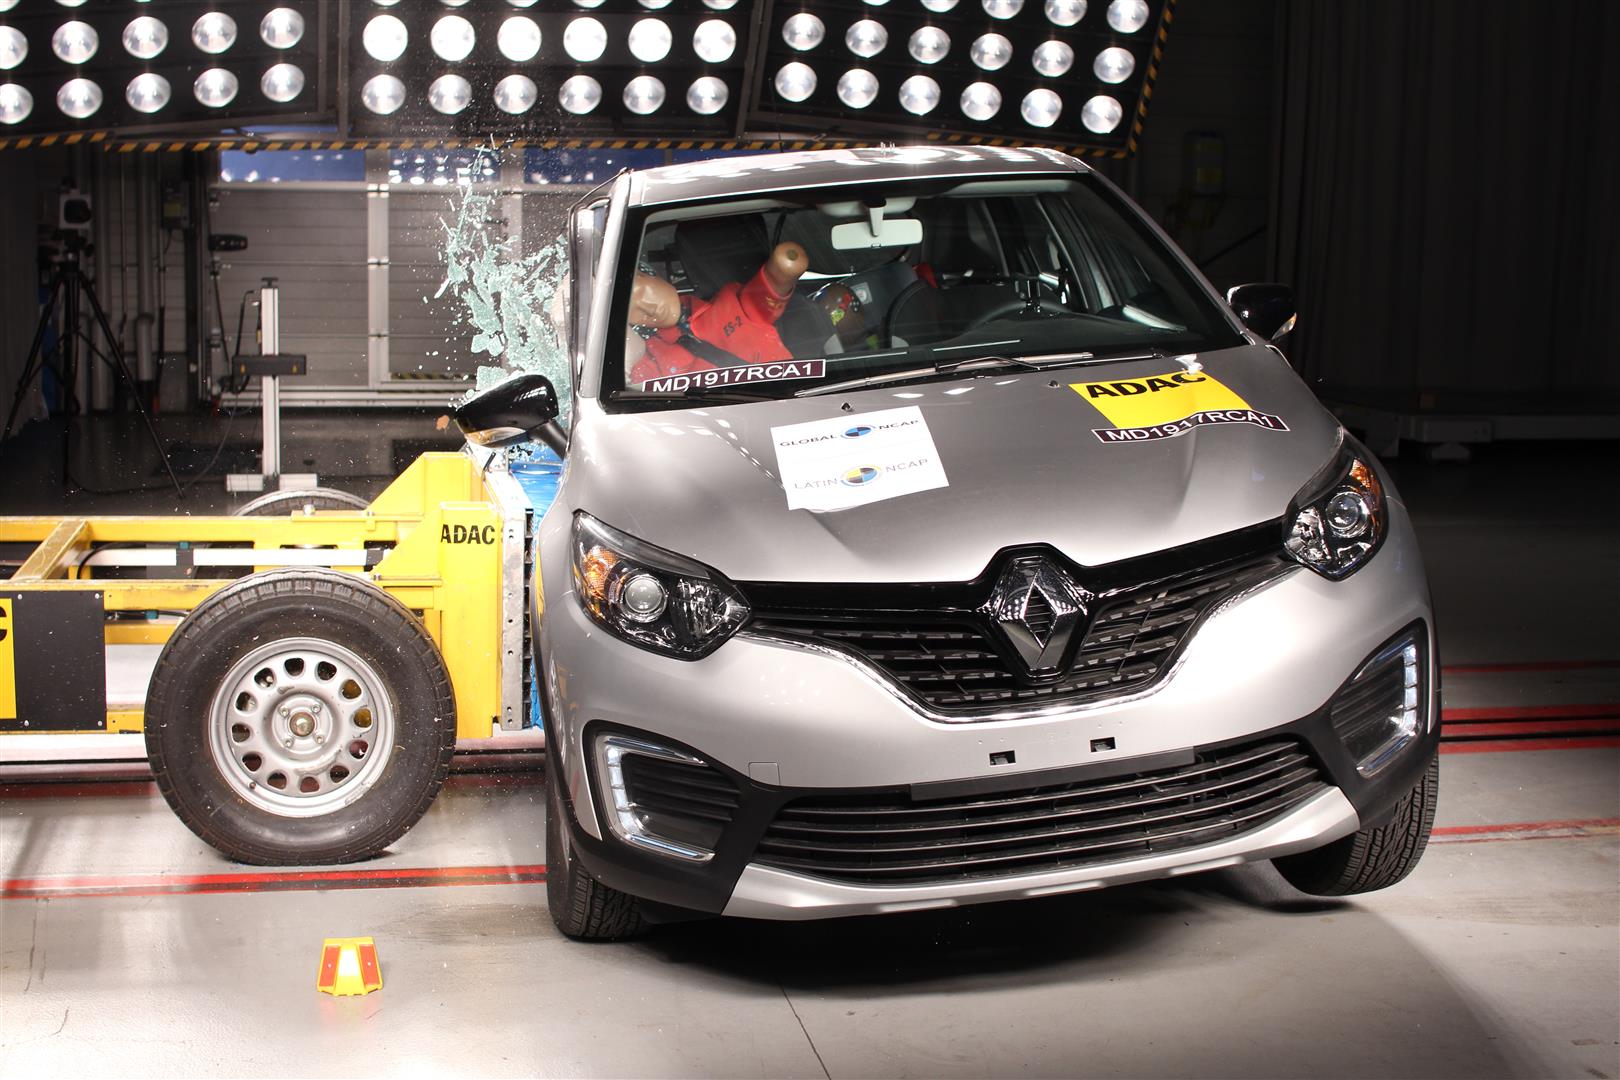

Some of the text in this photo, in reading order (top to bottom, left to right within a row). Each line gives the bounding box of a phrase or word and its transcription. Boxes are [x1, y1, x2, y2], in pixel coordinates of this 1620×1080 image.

[652, 362, 812, 393] MD1917RCA1
[1085, 372, 1206, 399] ADAC
[779, 419, 919, 447] GLOBAL NCAP
[1105, 410, 1275, 441] MD1917RCA1
[794, 458, 928, 490] LATIN NCAP
[440, 523, 496, 545] ADAC
